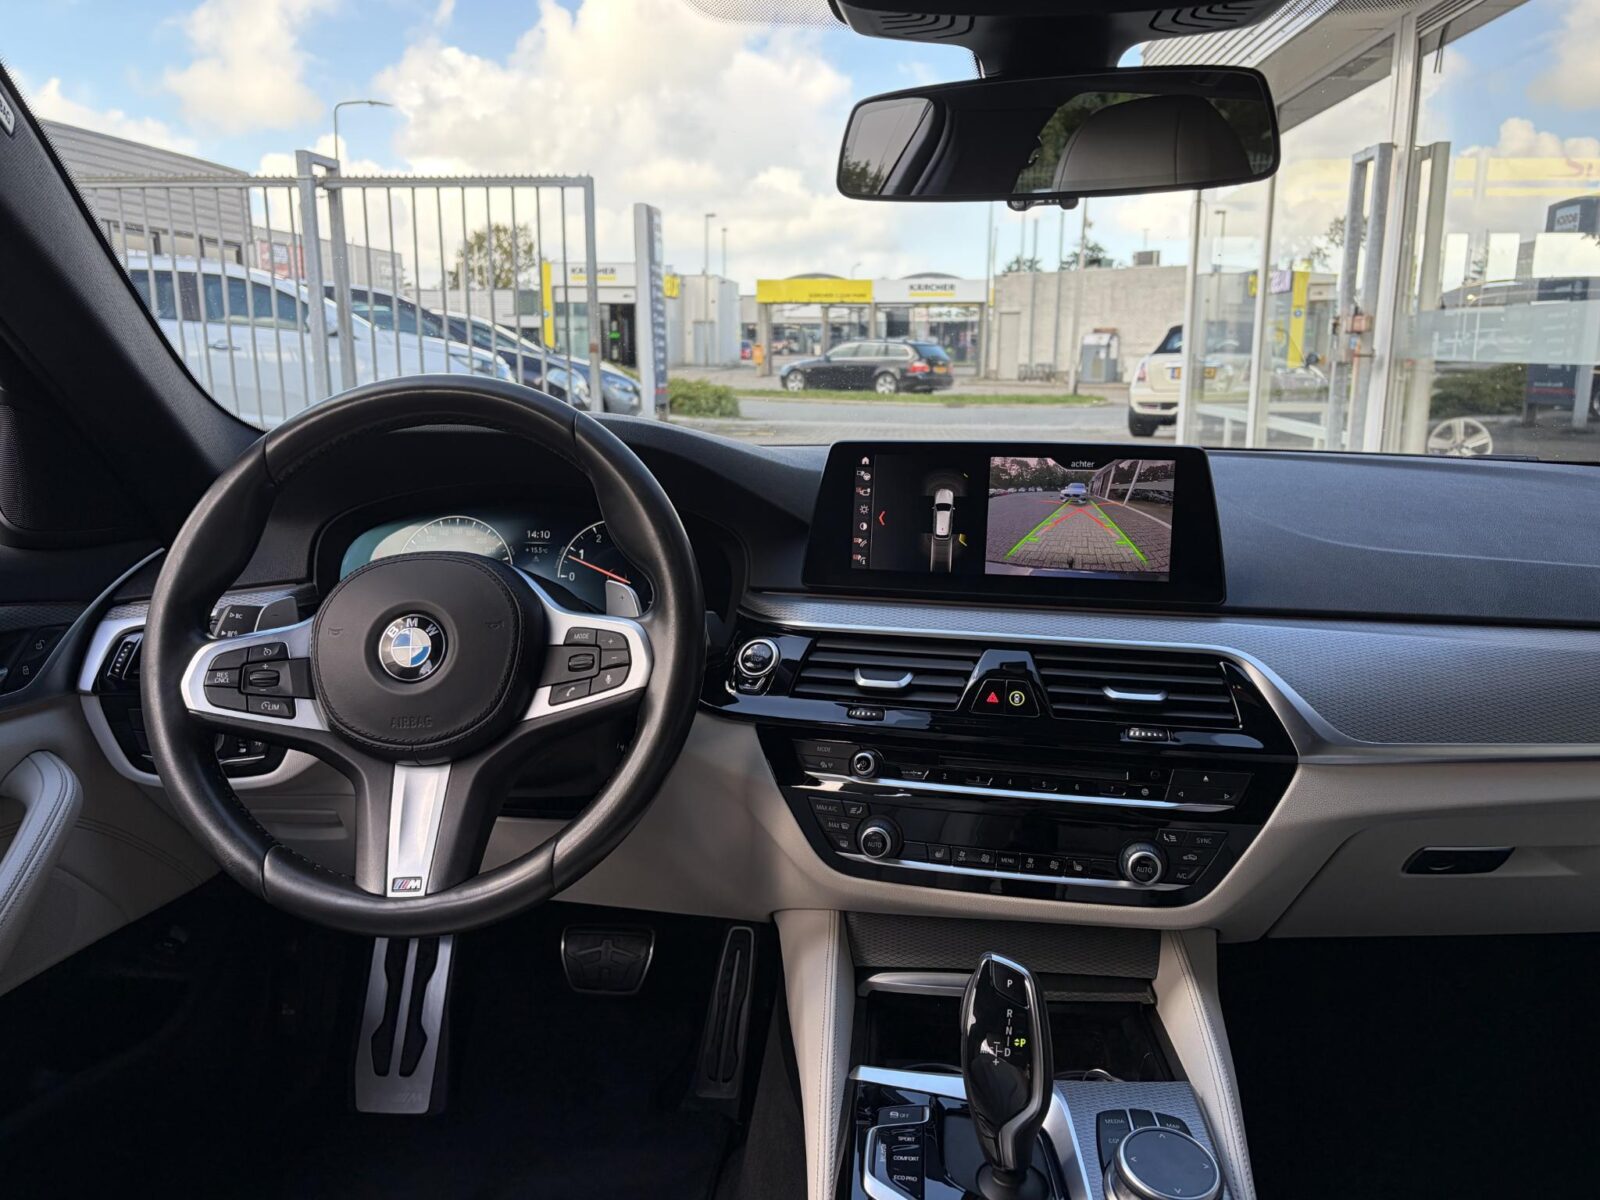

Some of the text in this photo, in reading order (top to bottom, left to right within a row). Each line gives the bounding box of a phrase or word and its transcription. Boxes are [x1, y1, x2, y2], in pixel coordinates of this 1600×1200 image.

[1071, 460, 1095, 468] achter
[526, 530, 551, 539] 14:10
[595, 534, 602, 543] 2
[578, 549, 584, 559] 1
[568, 572, 575, 581] 0
[387, 617, 439, 638] BMW
[573, 632, 590, 640] MODE
[267, 703, 280, 711] LIM
[391, 714, 433, 729] AIRBAG
[816, 745, 832, 753] MODE
[867, 841, 882, 849] AUTO
[1136, 866, 1153, 874] AUTO
[1007, 979, 1013, 988] P
[1006, 1009, 1013, 1018] R
[1005, 1026, 1012, 1035] N
[1019, 1038, 1026, 1047] P
[1004, 1047, 1011, 1057] D
